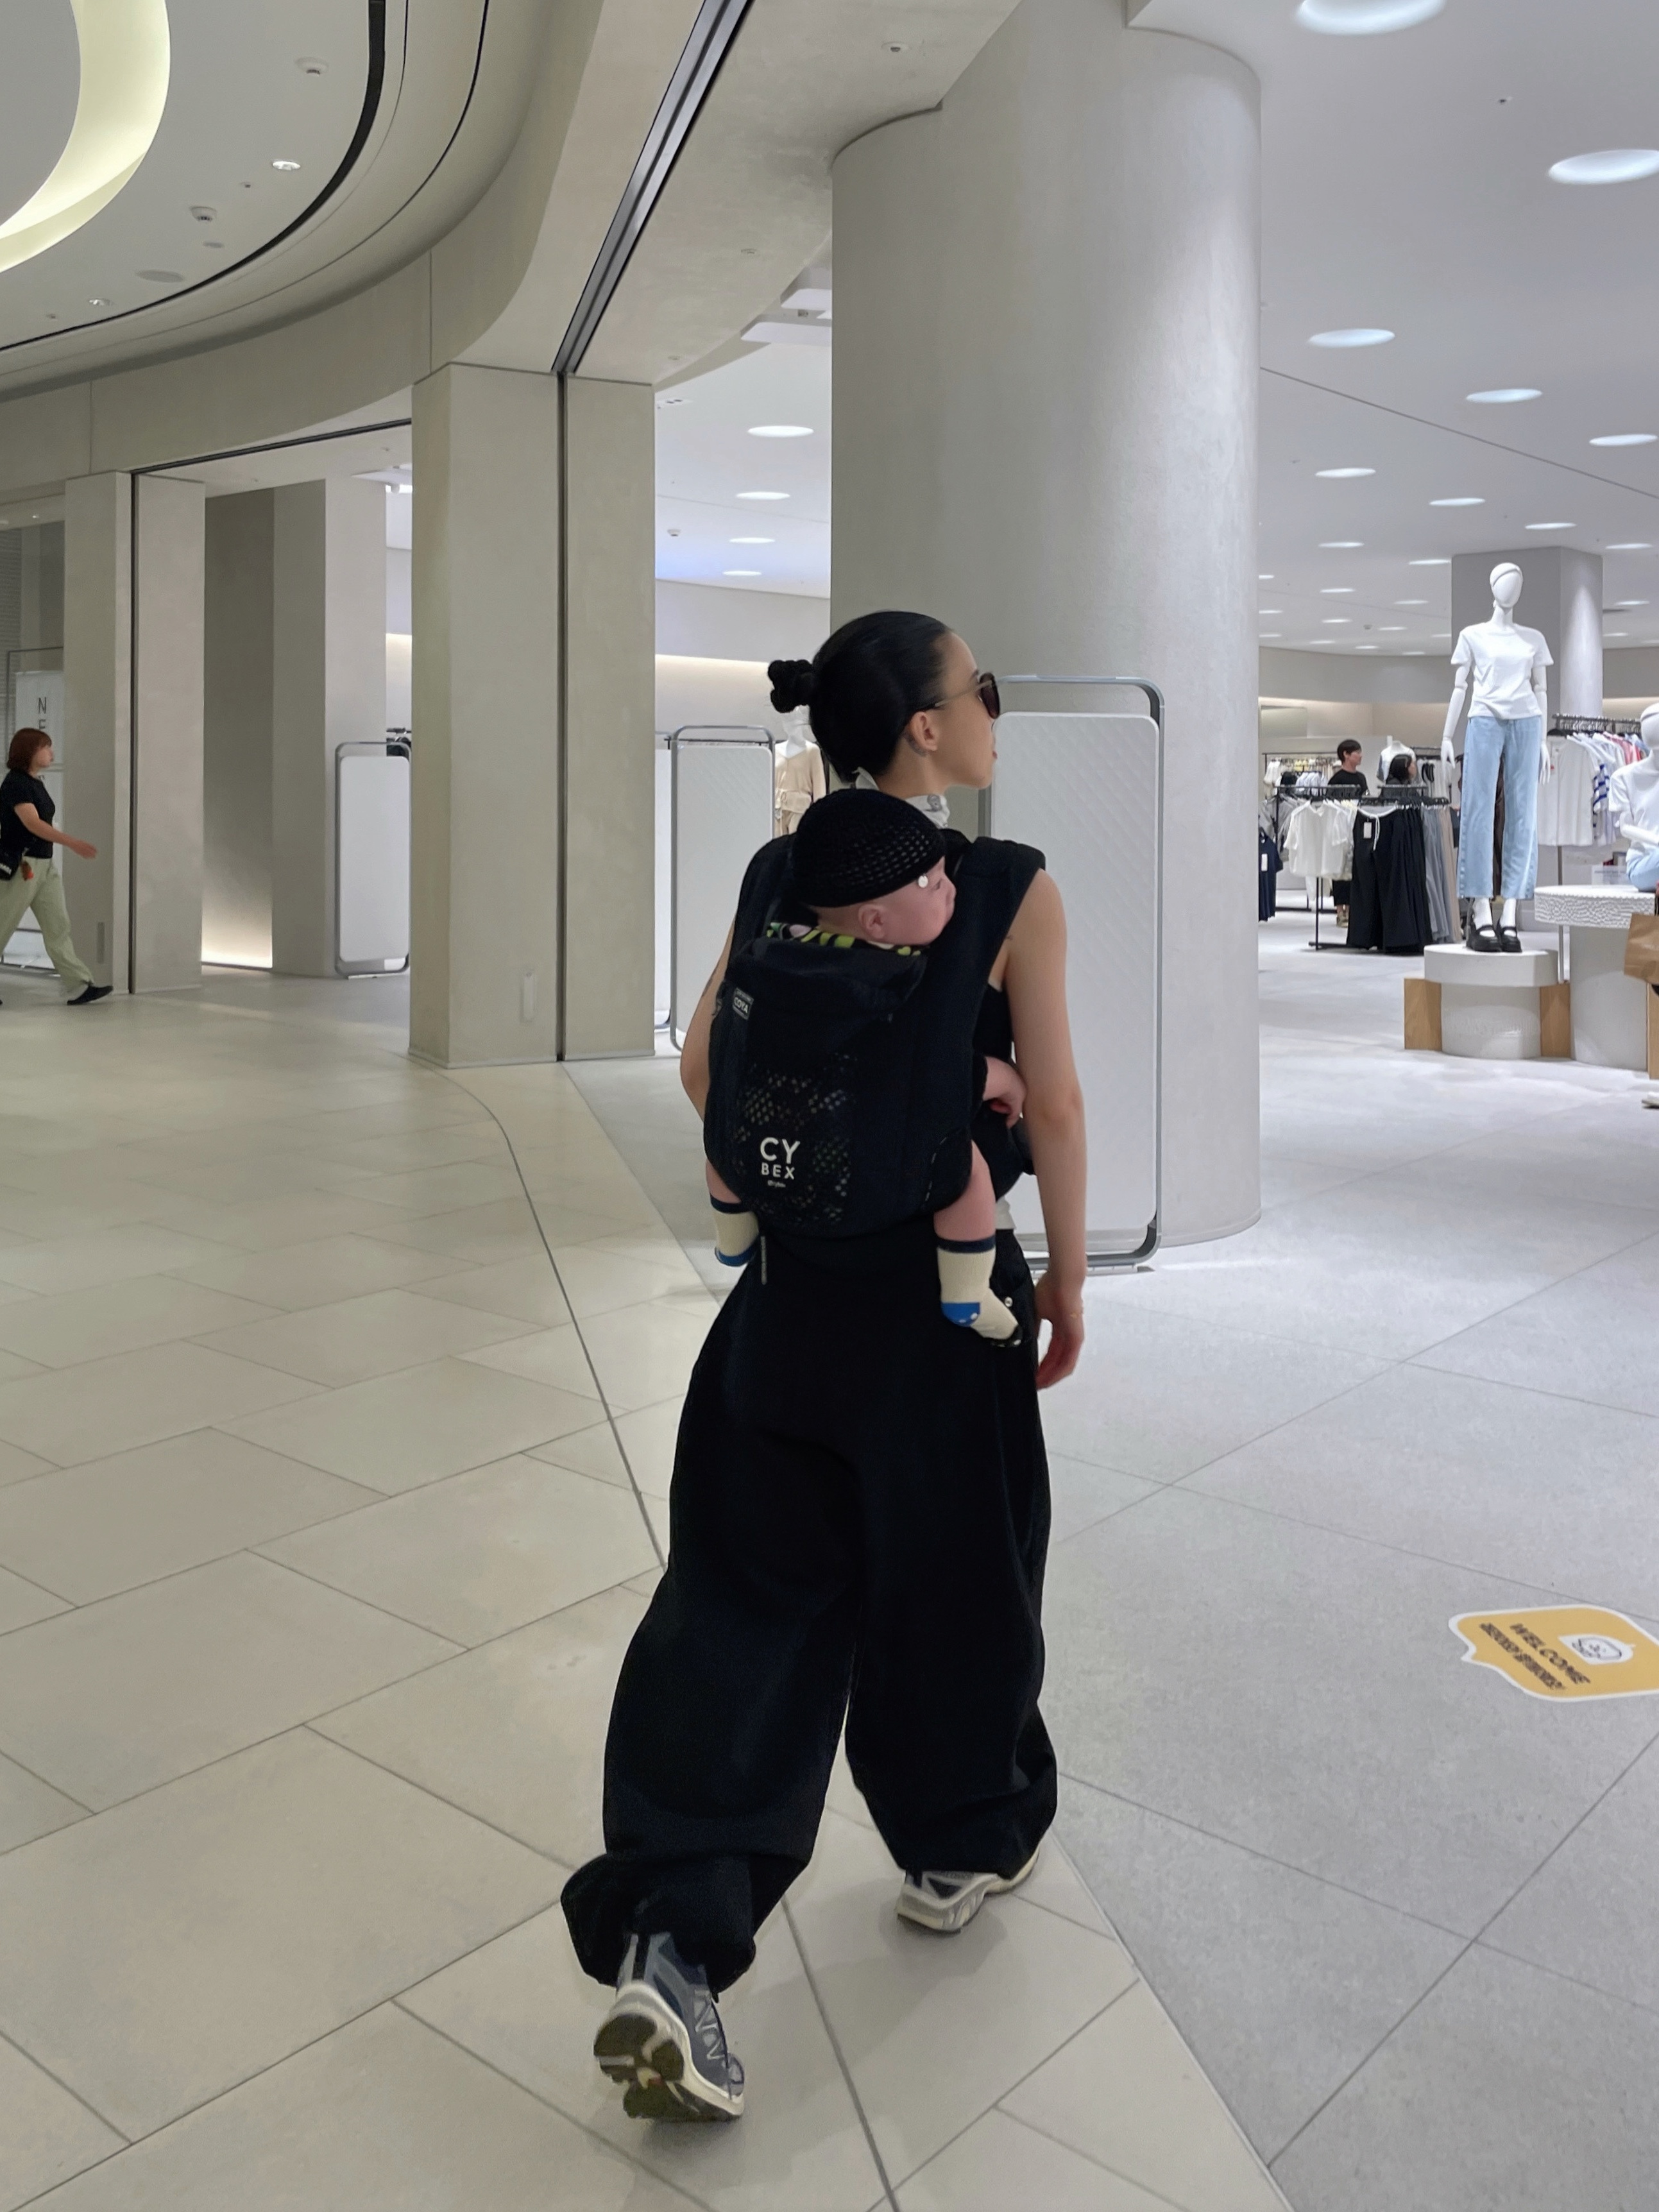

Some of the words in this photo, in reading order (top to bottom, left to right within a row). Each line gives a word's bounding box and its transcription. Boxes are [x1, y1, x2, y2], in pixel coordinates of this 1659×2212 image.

[760, 1137, 801, 1164] CY
[761, 1162, 795, 1180] BEX
[1510, 1623, 1591, 1684] WELCOME
